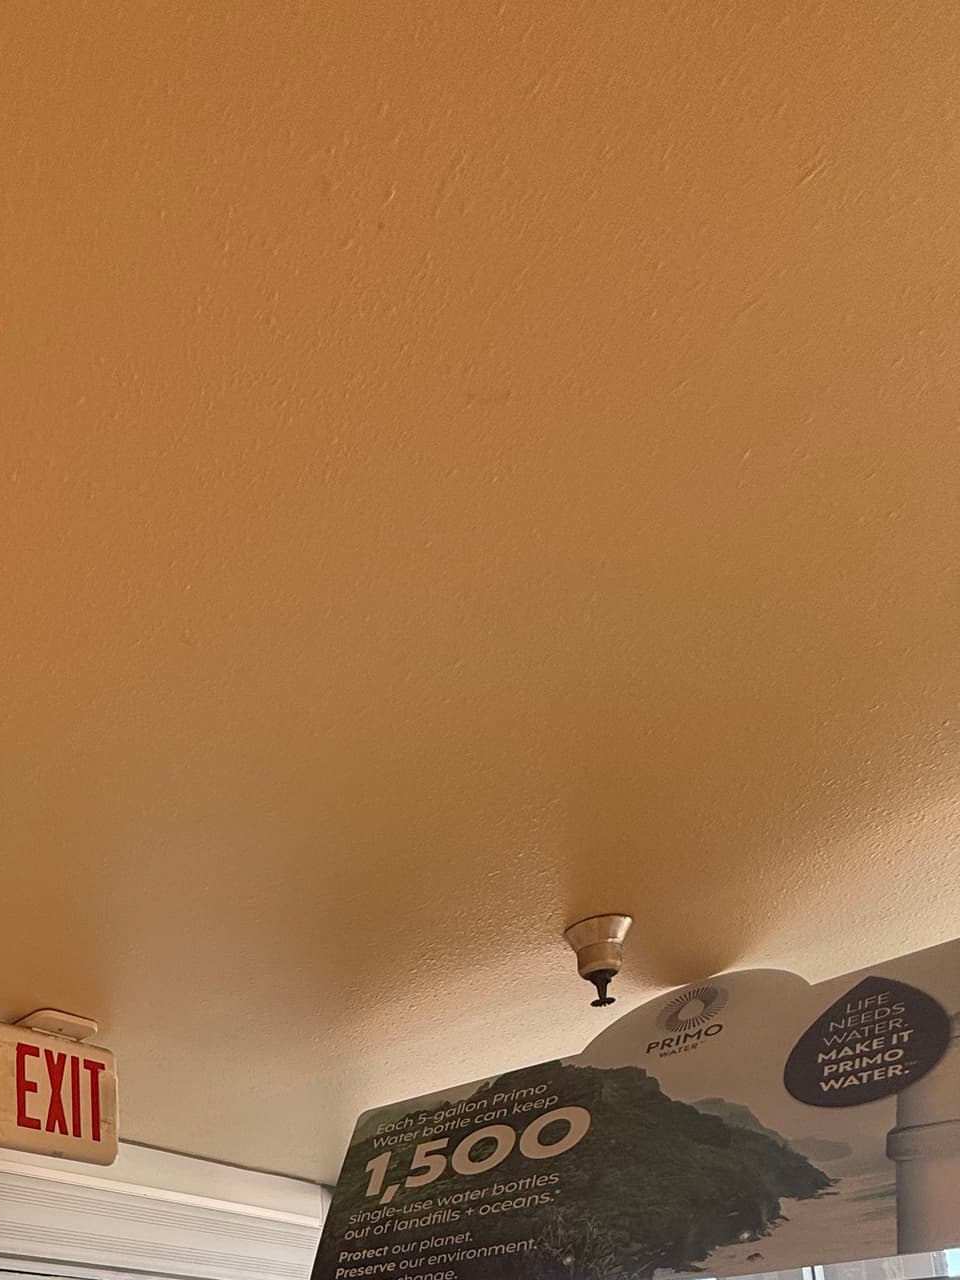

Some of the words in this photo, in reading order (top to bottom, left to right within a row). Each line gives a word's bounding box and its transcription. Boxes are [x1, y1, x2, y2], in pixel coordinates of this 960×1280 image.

[829, 1002, 905, 1032] NEEDS
[846, 991, 889, 1013] LIFE
[646, 1024, 723, 1054] PRIMO
[817, 1036, 886, 1064] MAKE
[891, 1029, 914, 1045] IT
[823, 1018, 909, 1047] WATER.
[659, 1043, 698, 1058] WATER
[823, 1049, 904, 1077] PRIMO
[15, 1041, 105, 1142] EXIT
[820, 1064, 910, 1092] WATER.
[373, 1130, 420, 1149] Water
[422, 1117, 471, 1137] bottle
[474, 1108, 507, 1124] can
[512, 1095, 558, 1114] keep
[376, 1118, 413, 1135] Each
[417, 1099, 487, 1127] 5-gallon
[492, 1084, 547, 1105] Primo
[365, 1106, 591, 1204] 1,500
[349, 1199, 432, 1226] single-use
[437, 1187, 488, 1207] water
[491, 1172, 560, 1196] bottles
[344, 1227, 370, 1240] out
[373, 1221, 392, 1235] of
[393, 1208, 460, 1232] landfills
[335, 1260, 396, 1280] Preserve
[399, 1257, 426, 1270] our
[428, 1238, 537, 1265] environment.
[339, 1245, 388, 1263] Protect
[391, 1242, 417, 1255] our
[419, 1231, 473, 1252] planet.
